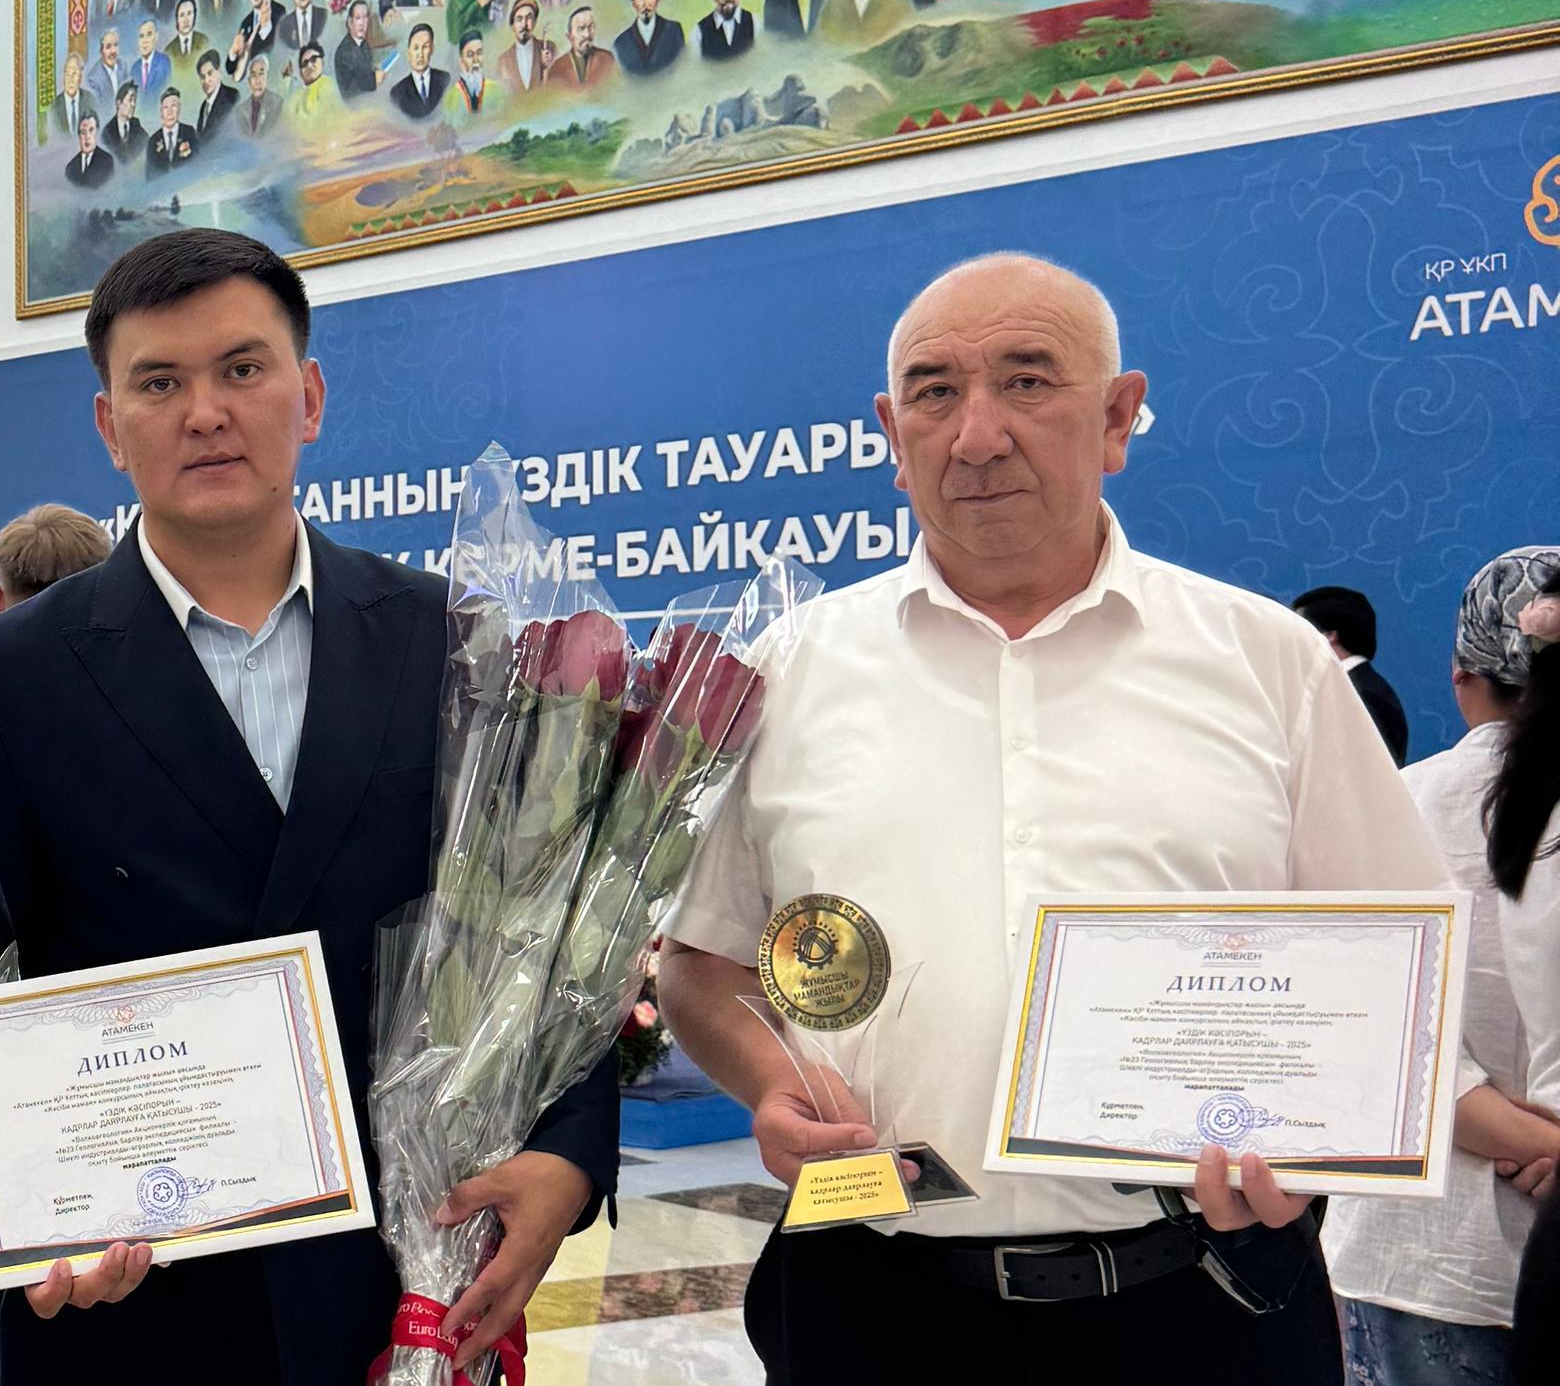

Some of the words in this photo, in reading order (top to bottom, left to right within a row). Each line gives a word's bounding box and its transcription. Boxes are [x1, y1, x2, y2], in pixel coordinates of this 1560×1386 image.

[1425, 259, 1455, 283] ҚР
[1460, 252, 1507, 275] ҰКП
[514, 444, 642, 508] ЗДІК
[1202, 951, 1262, 960] АТАМЕКЕН
[1167, 976, 1291, 994] ДИПЛОМ
[101, 1021, 154, 1037] АТАМЕКЕН
[76, 1040, 188, 1076] ДИПЛОМ
[60, 1120, 98, 1135] КАДРЛАР
[54, 1202, 90, 1216] Директор
[408, 1321, 436, 1337] Euro
